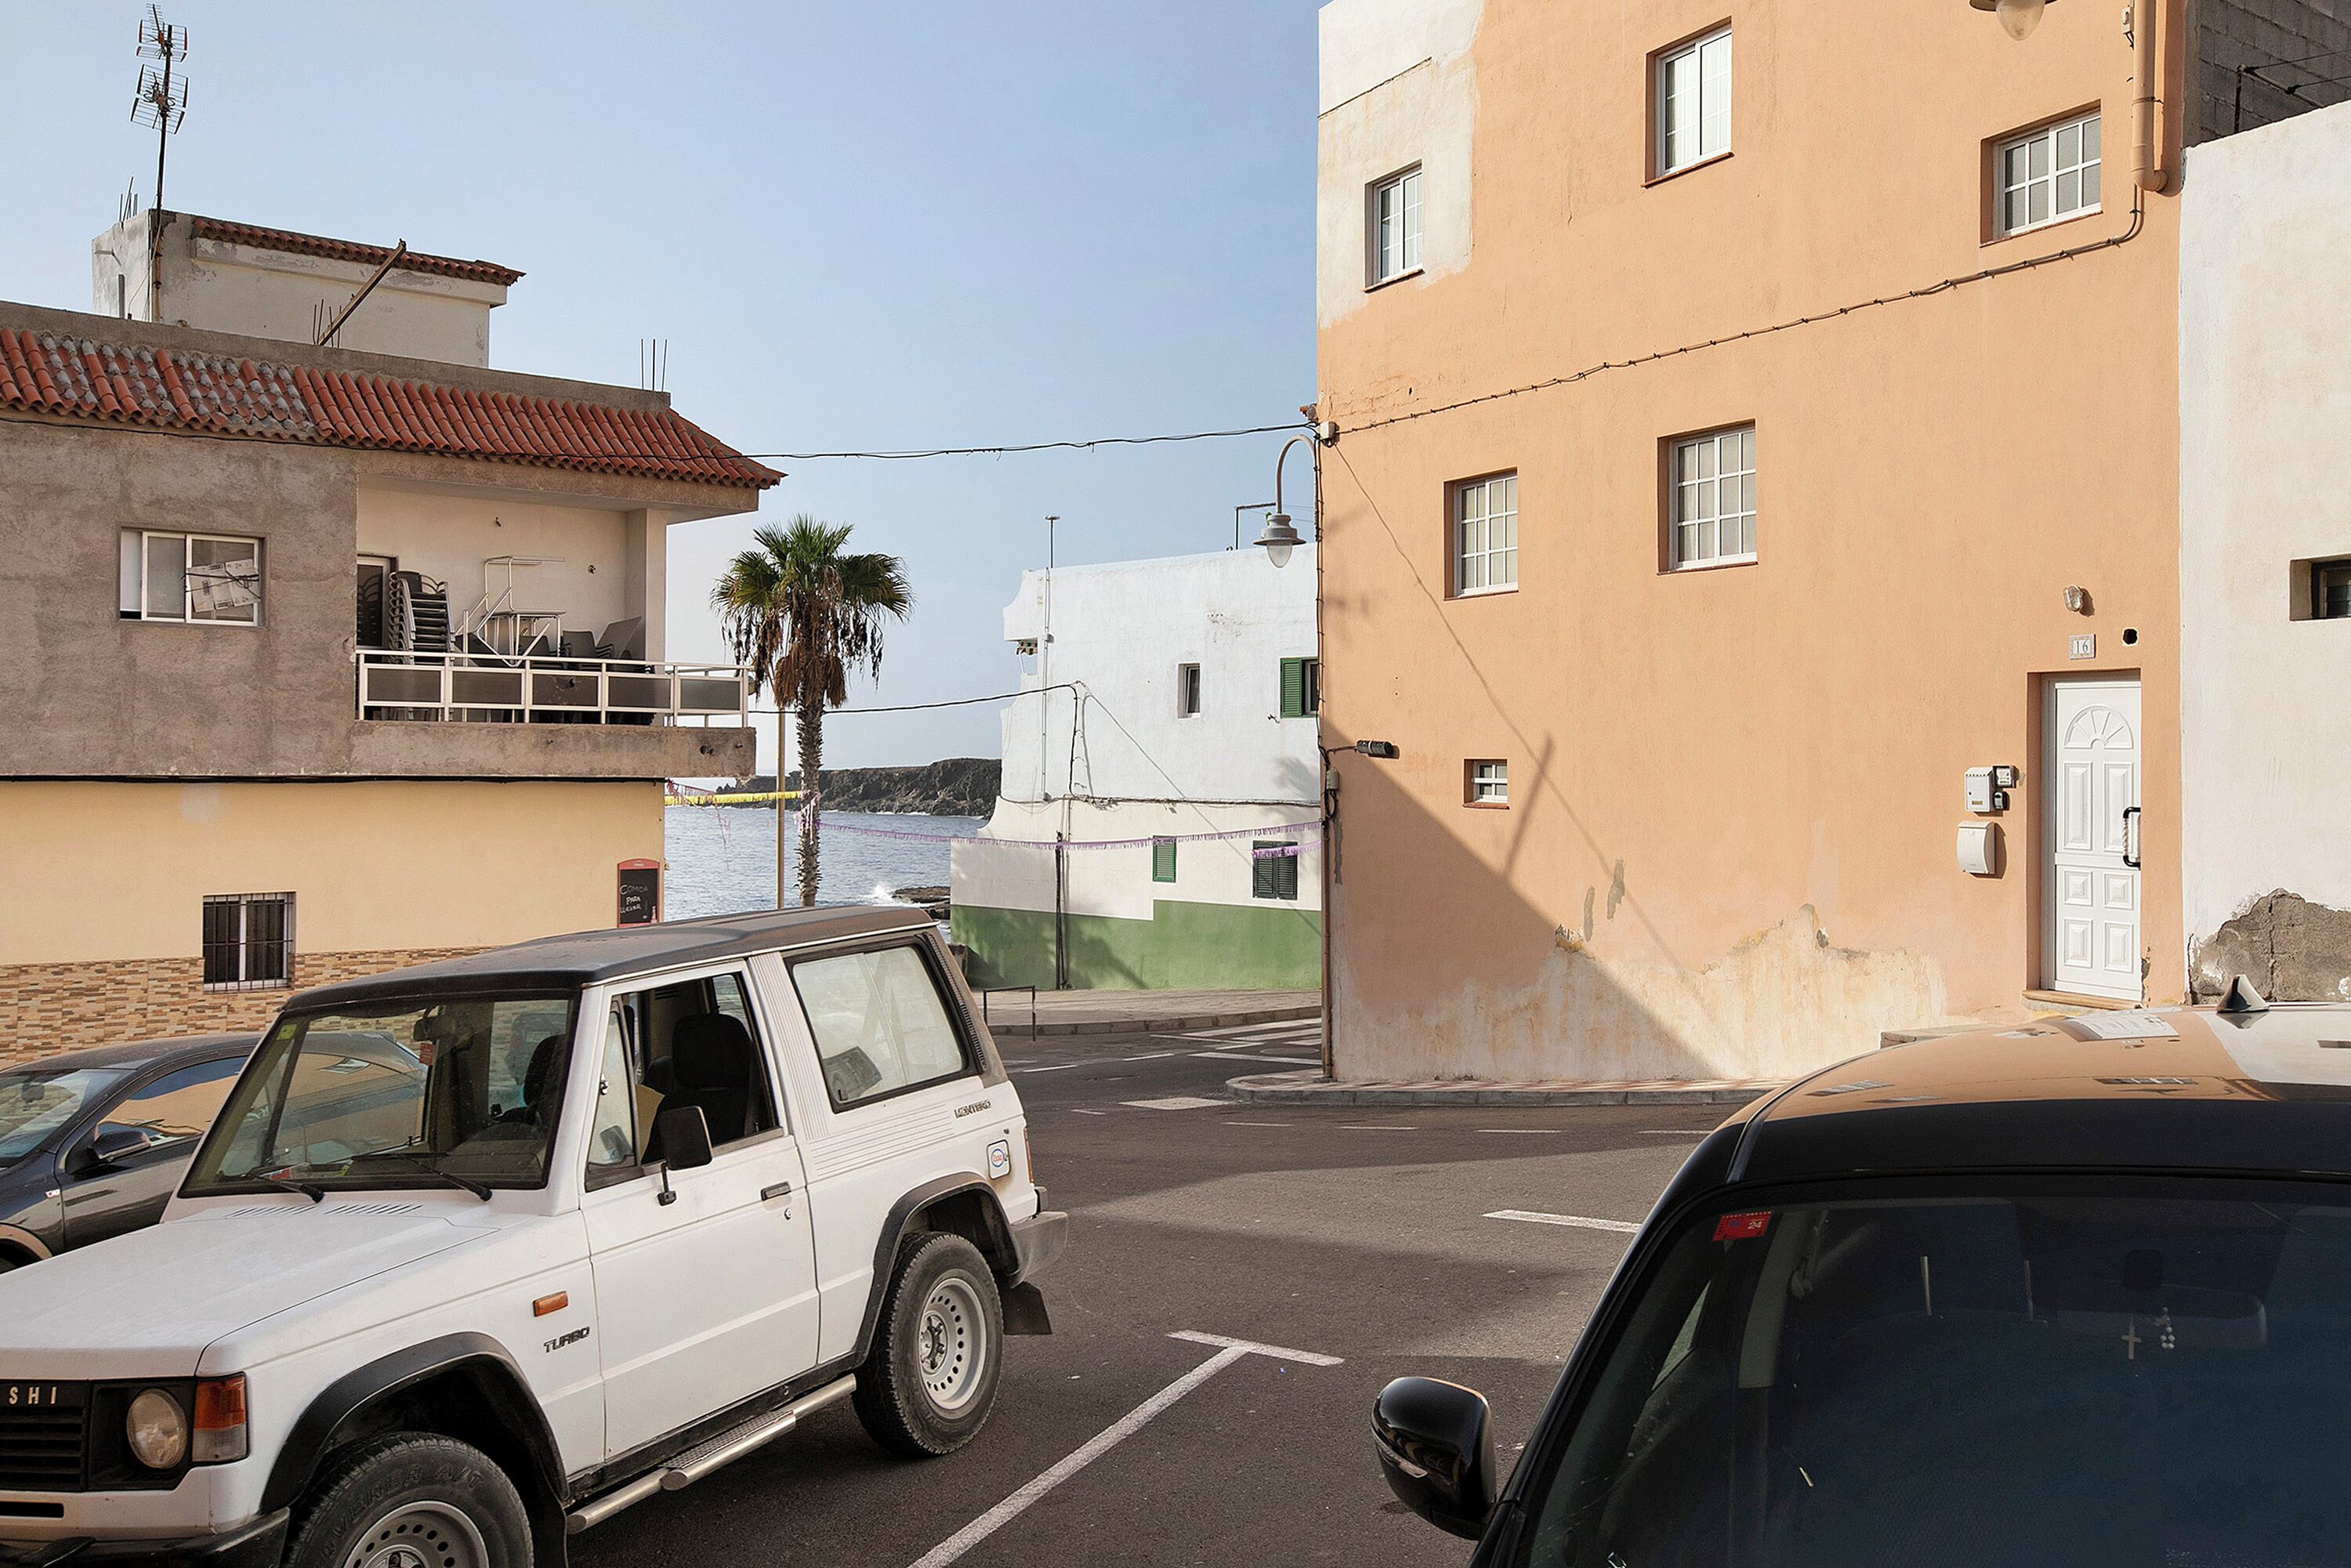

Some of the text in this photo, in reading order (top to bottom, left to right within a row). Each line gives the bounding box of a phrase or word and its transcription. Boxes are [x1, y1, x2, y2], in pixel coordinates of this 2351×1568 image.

[2076, 639, 2088, 654] 16
[625, 896, 641, 905] PARA
[954, 1099, 991, 1119] MONTERO
[1747, 1221, 1762, 1229] 24
[543, 1326, 590, 1353] TURBO
